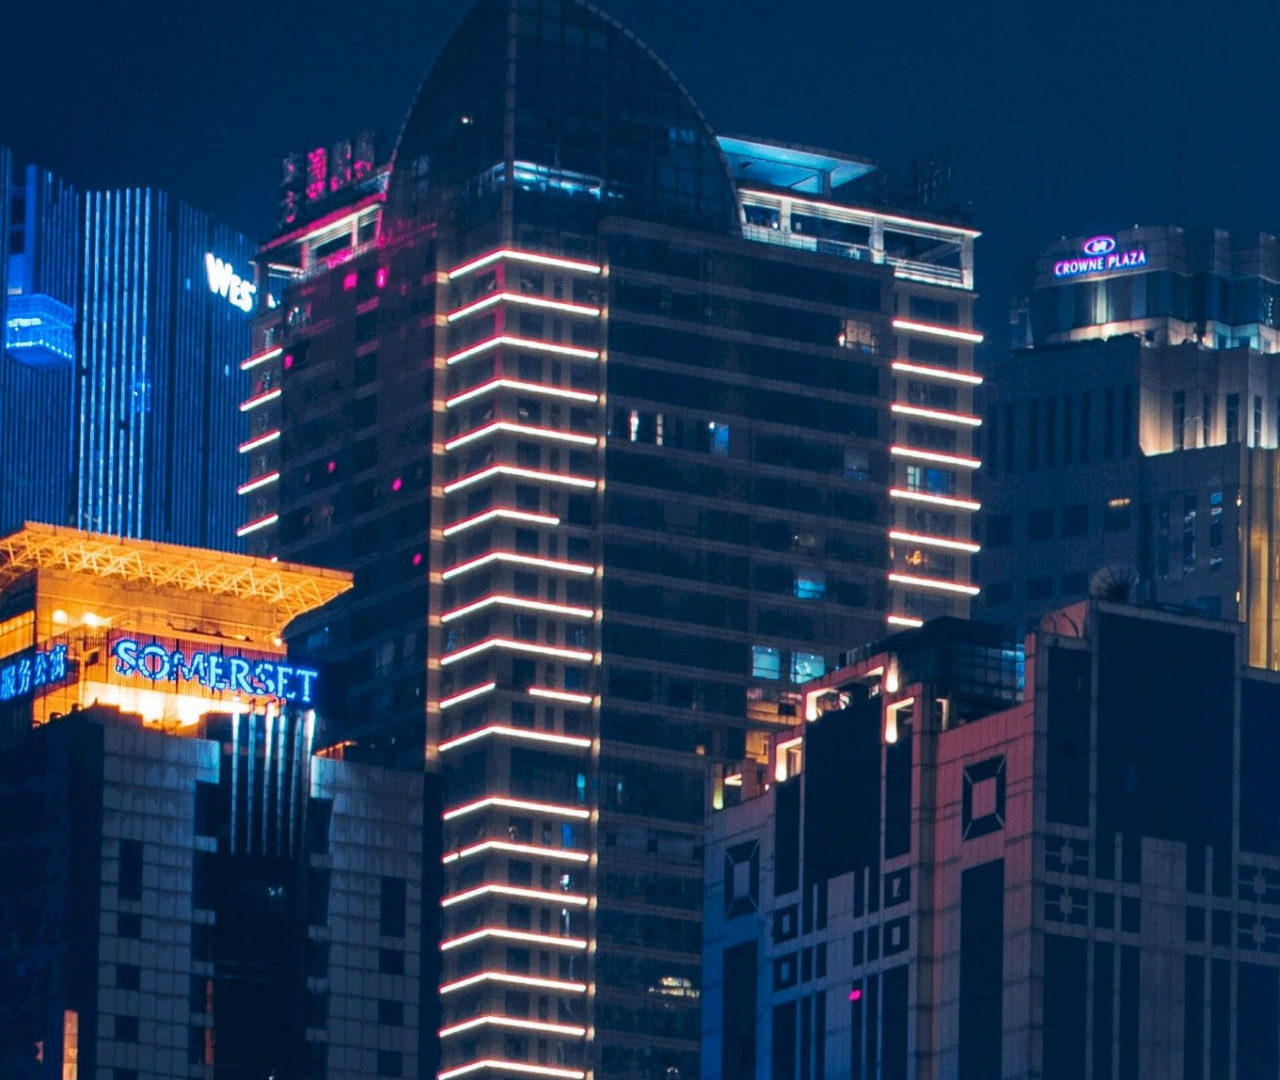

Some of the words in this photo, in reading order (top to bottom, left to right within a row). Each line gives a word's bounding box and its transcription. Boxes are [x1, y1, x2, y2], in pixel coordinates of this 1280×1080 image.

[1054, 257, 1104, 277] CROWNE
[1106, 250, 1146, 269] PLAZA
[113, 638, 318, 702] SOMERSET
